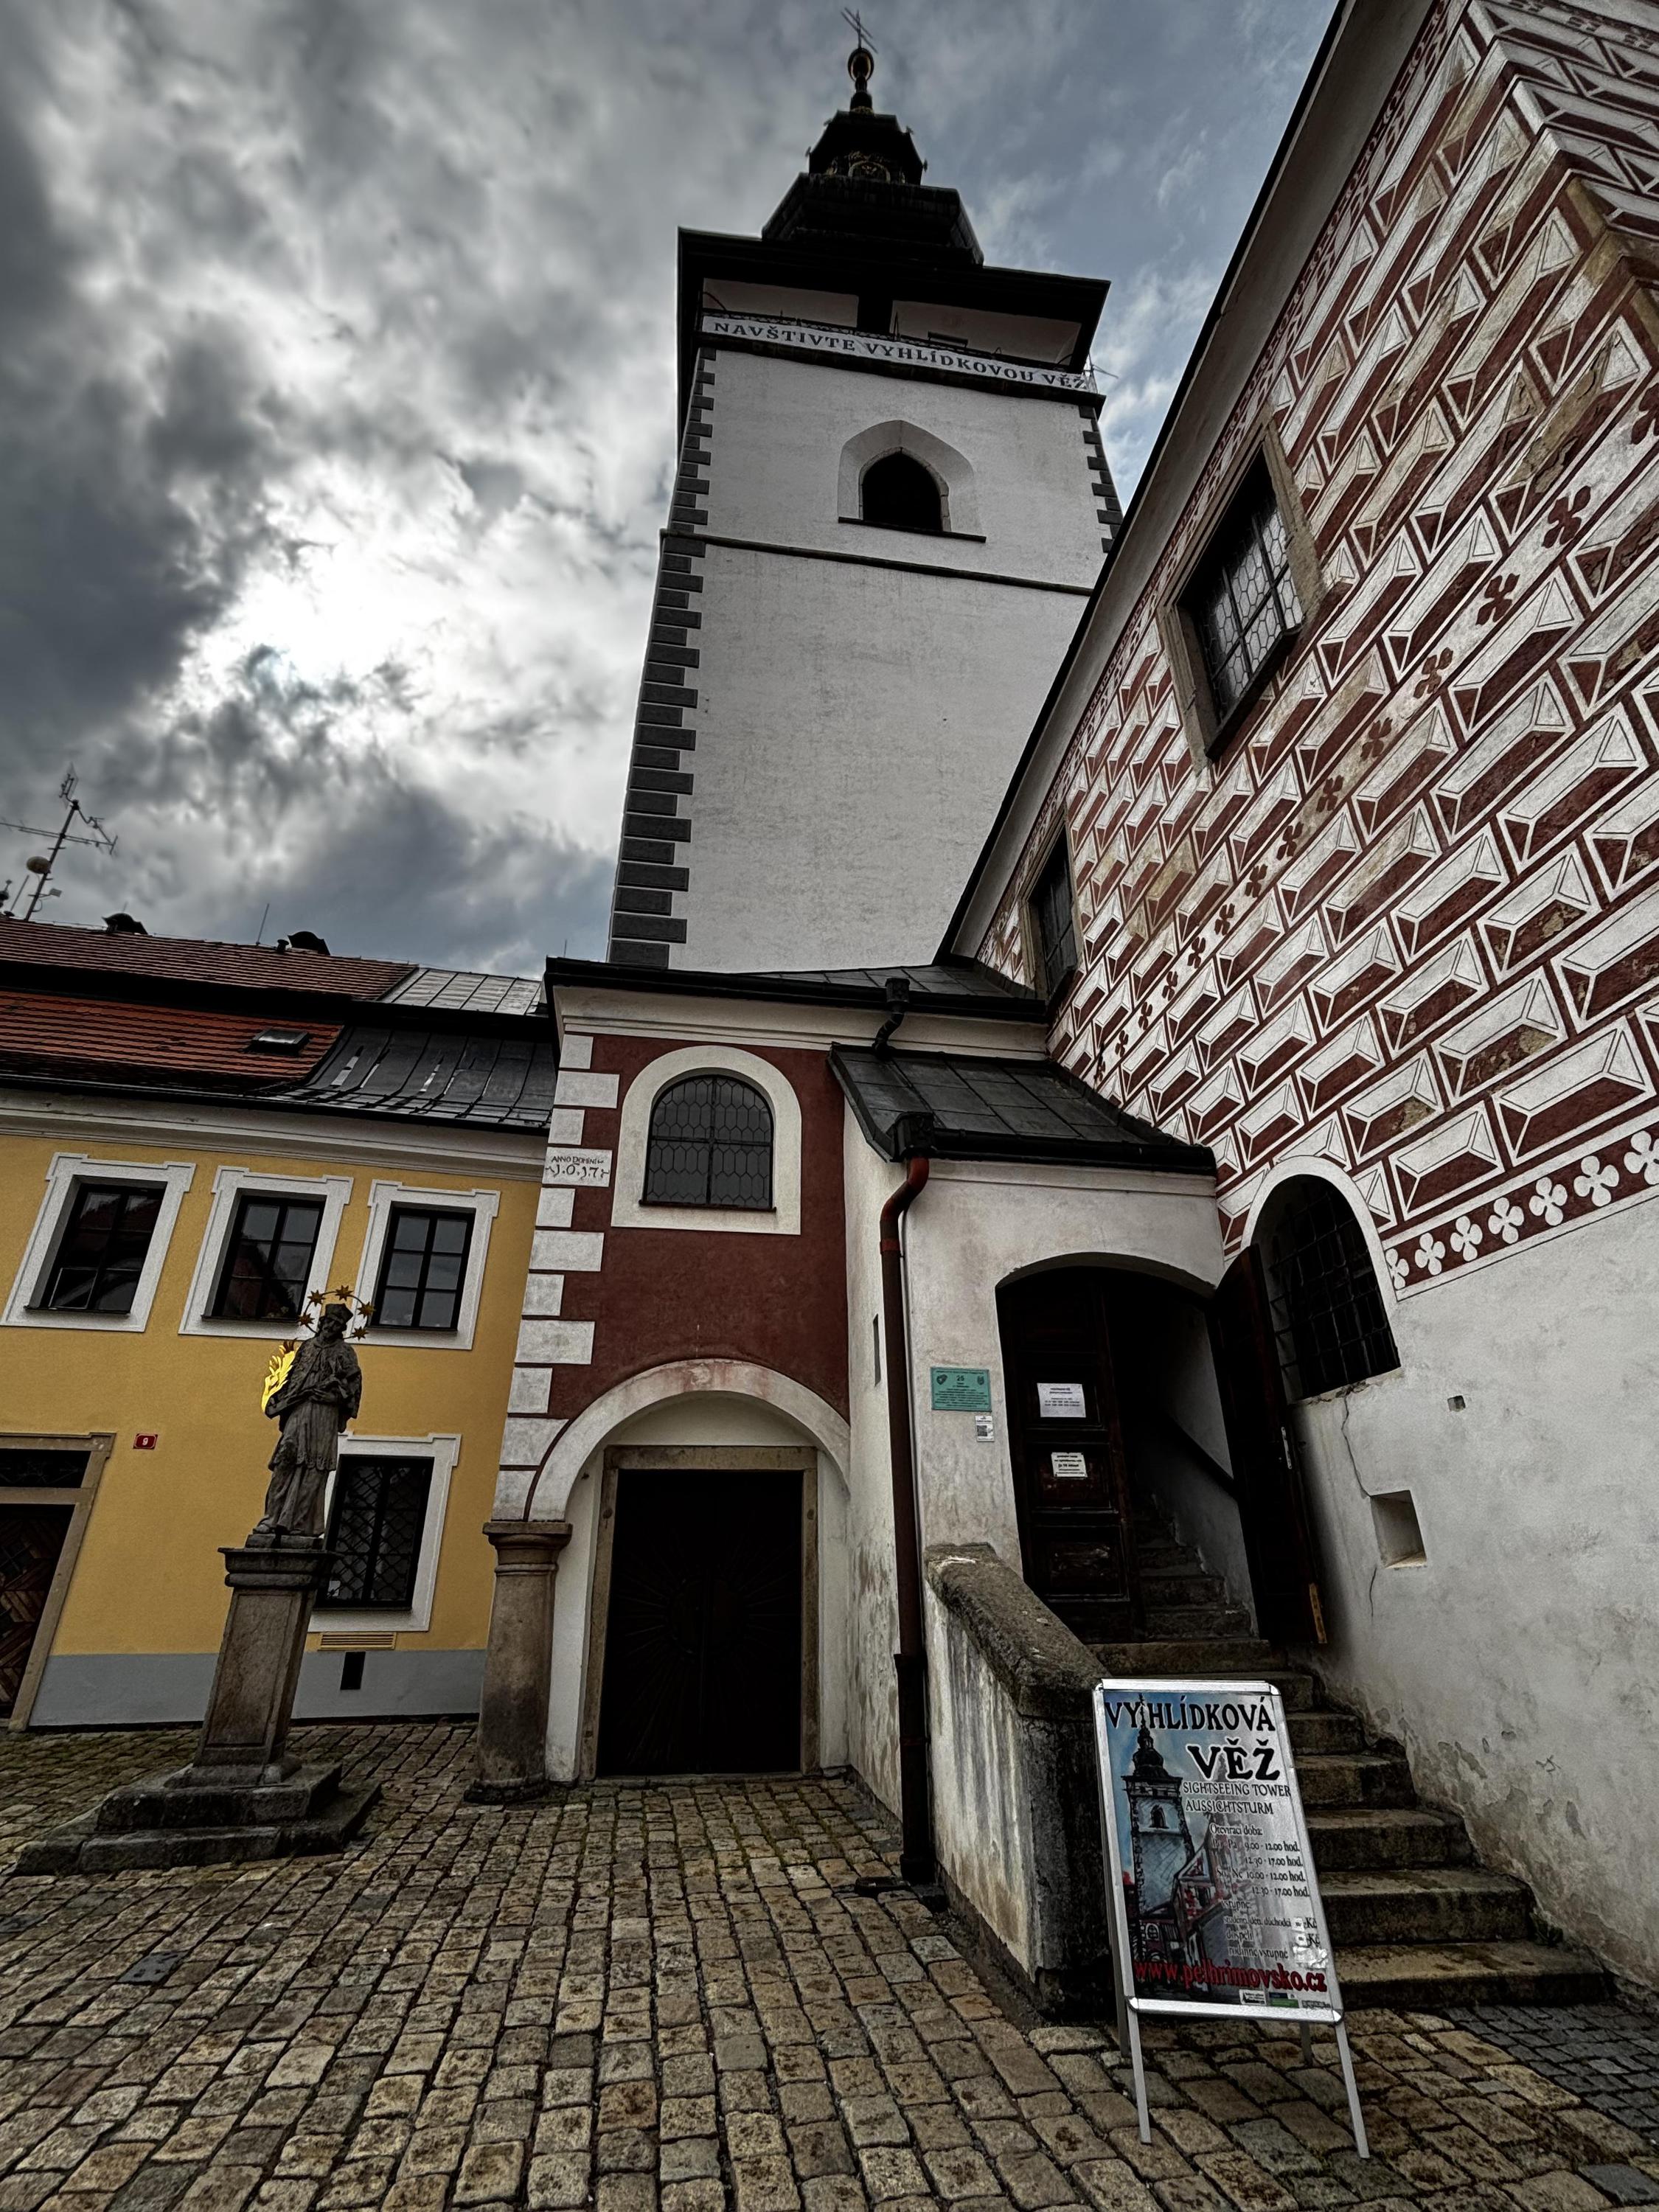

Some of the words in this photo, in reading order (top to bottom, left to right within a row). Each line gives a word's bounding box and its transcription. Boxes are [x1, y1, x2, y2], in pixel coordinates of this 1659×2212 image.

[714, 322, 855, 352] NAVŠTIVTE
[864, 343, 1034, 382] VYHLÍDKOVOU
[551, 1155, 571, 1164] ANNO
[142, 1437, 148, 1446] 9
[1106, 1695, 1276, 1731] VYHLÍDKOVÁ
[1187, 1738, 1280, 1781] VĚŽ
[1183, 1781, 1250, 1798] SIGHTSEEING
[1251, 1784, 1291, 1797] TOWER
[1186, 1799, 1274, 1815] AUSSICHTSTURM
[1245, 1842, 1260, 1851] 9.00
[1265, 1843, 1283, 1851] 12.00
[1283, 1840, 1300, 1851] hod.
[1268, 1857, 1285, 1867] 17.00
[1286, 1855, 1304, 1867] hod.
[1246, 1871, 1265, 1879] 10.00
[1270, 1873, 1288, 1881] 12.00
[1289, 1870, 1306, 1882] hod.
[1274, 1888, 1292, 1897] 17.00
[1293, 1885, 1310, 1897] hod.
